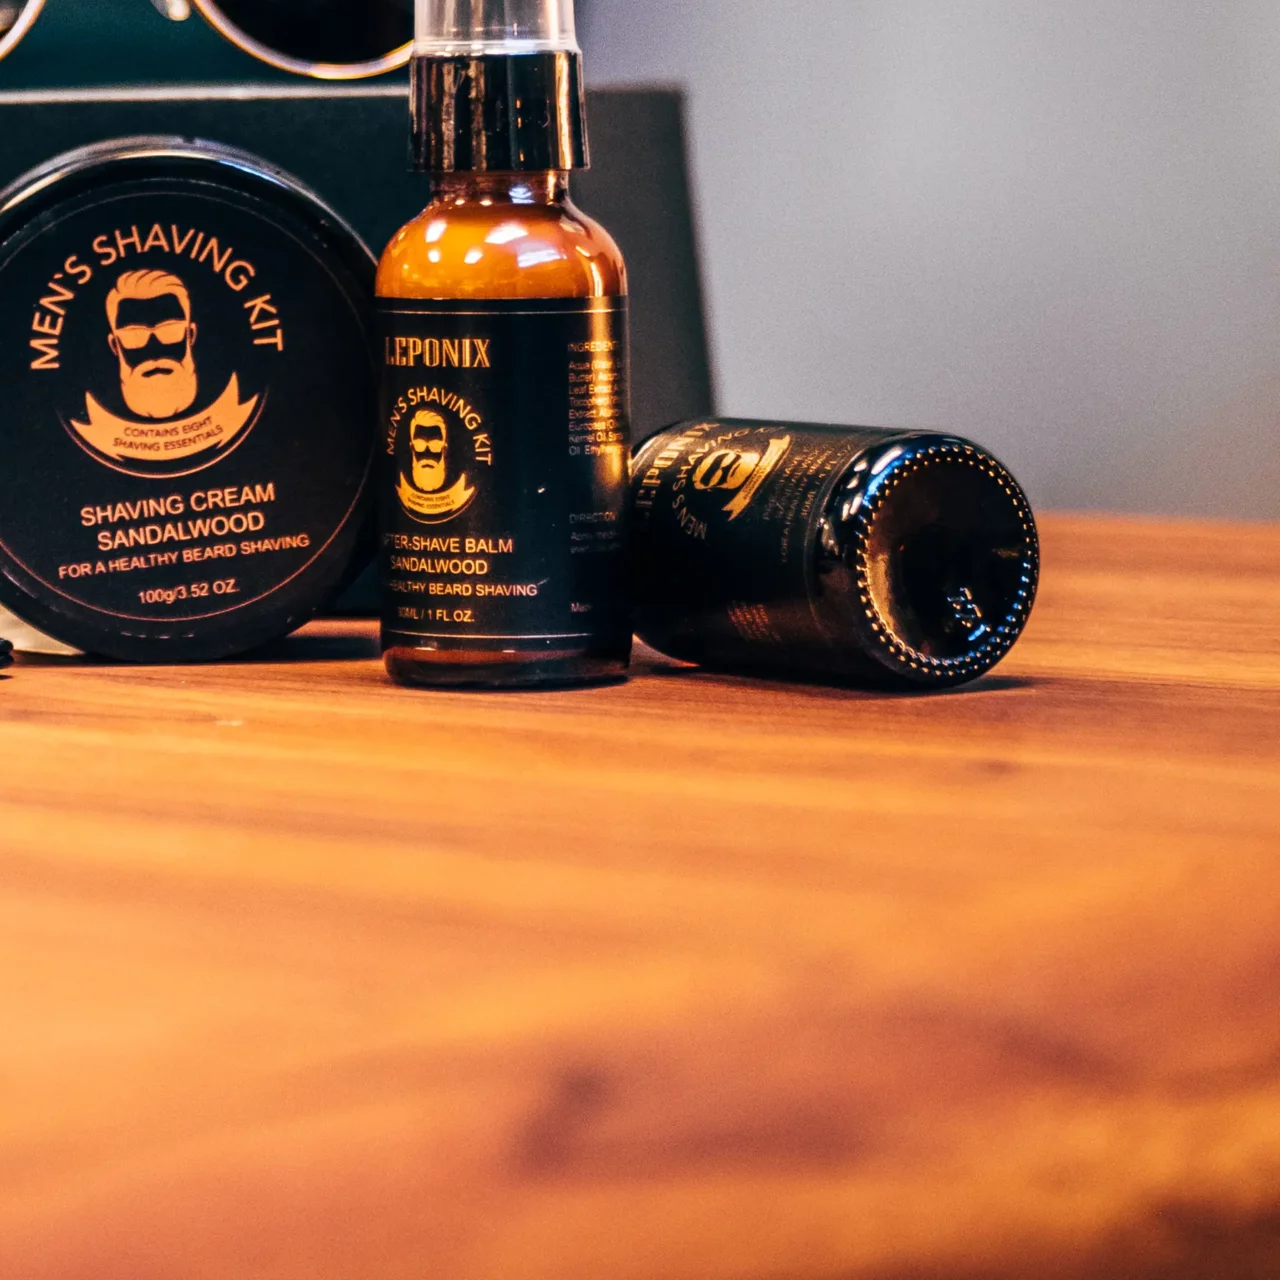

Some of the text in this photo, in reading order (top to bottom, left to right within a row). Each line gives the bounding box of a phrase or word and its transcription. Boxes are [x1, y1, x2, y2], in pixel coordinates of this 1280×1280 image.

[29, 223, 284, 370] MEN'S SHAVING KIT
[112, 424, 224, 451] SHAVING ESSENTIALS
[123, 416, 212, 437] CONTAINS EIGHT
[407, 386, 482, 431] SHAVING
[472, 433, 492, 466] KIT
[80, 482, 276, 527] SHAVING CREAM
[97, 511, 265, 551] SANDALWOOD
[58, 534, 311, 579] FOR A HEALTHY BEARD SHAVING
[465, 538, 513, 553] BALM
[390, 555, 488, 575] SANDALWOOD
[138, 583, 209, 604] 100g/3.52
[428, 583, 472, 596] BEARD
[475, 583, 538, 597] SHAVING
